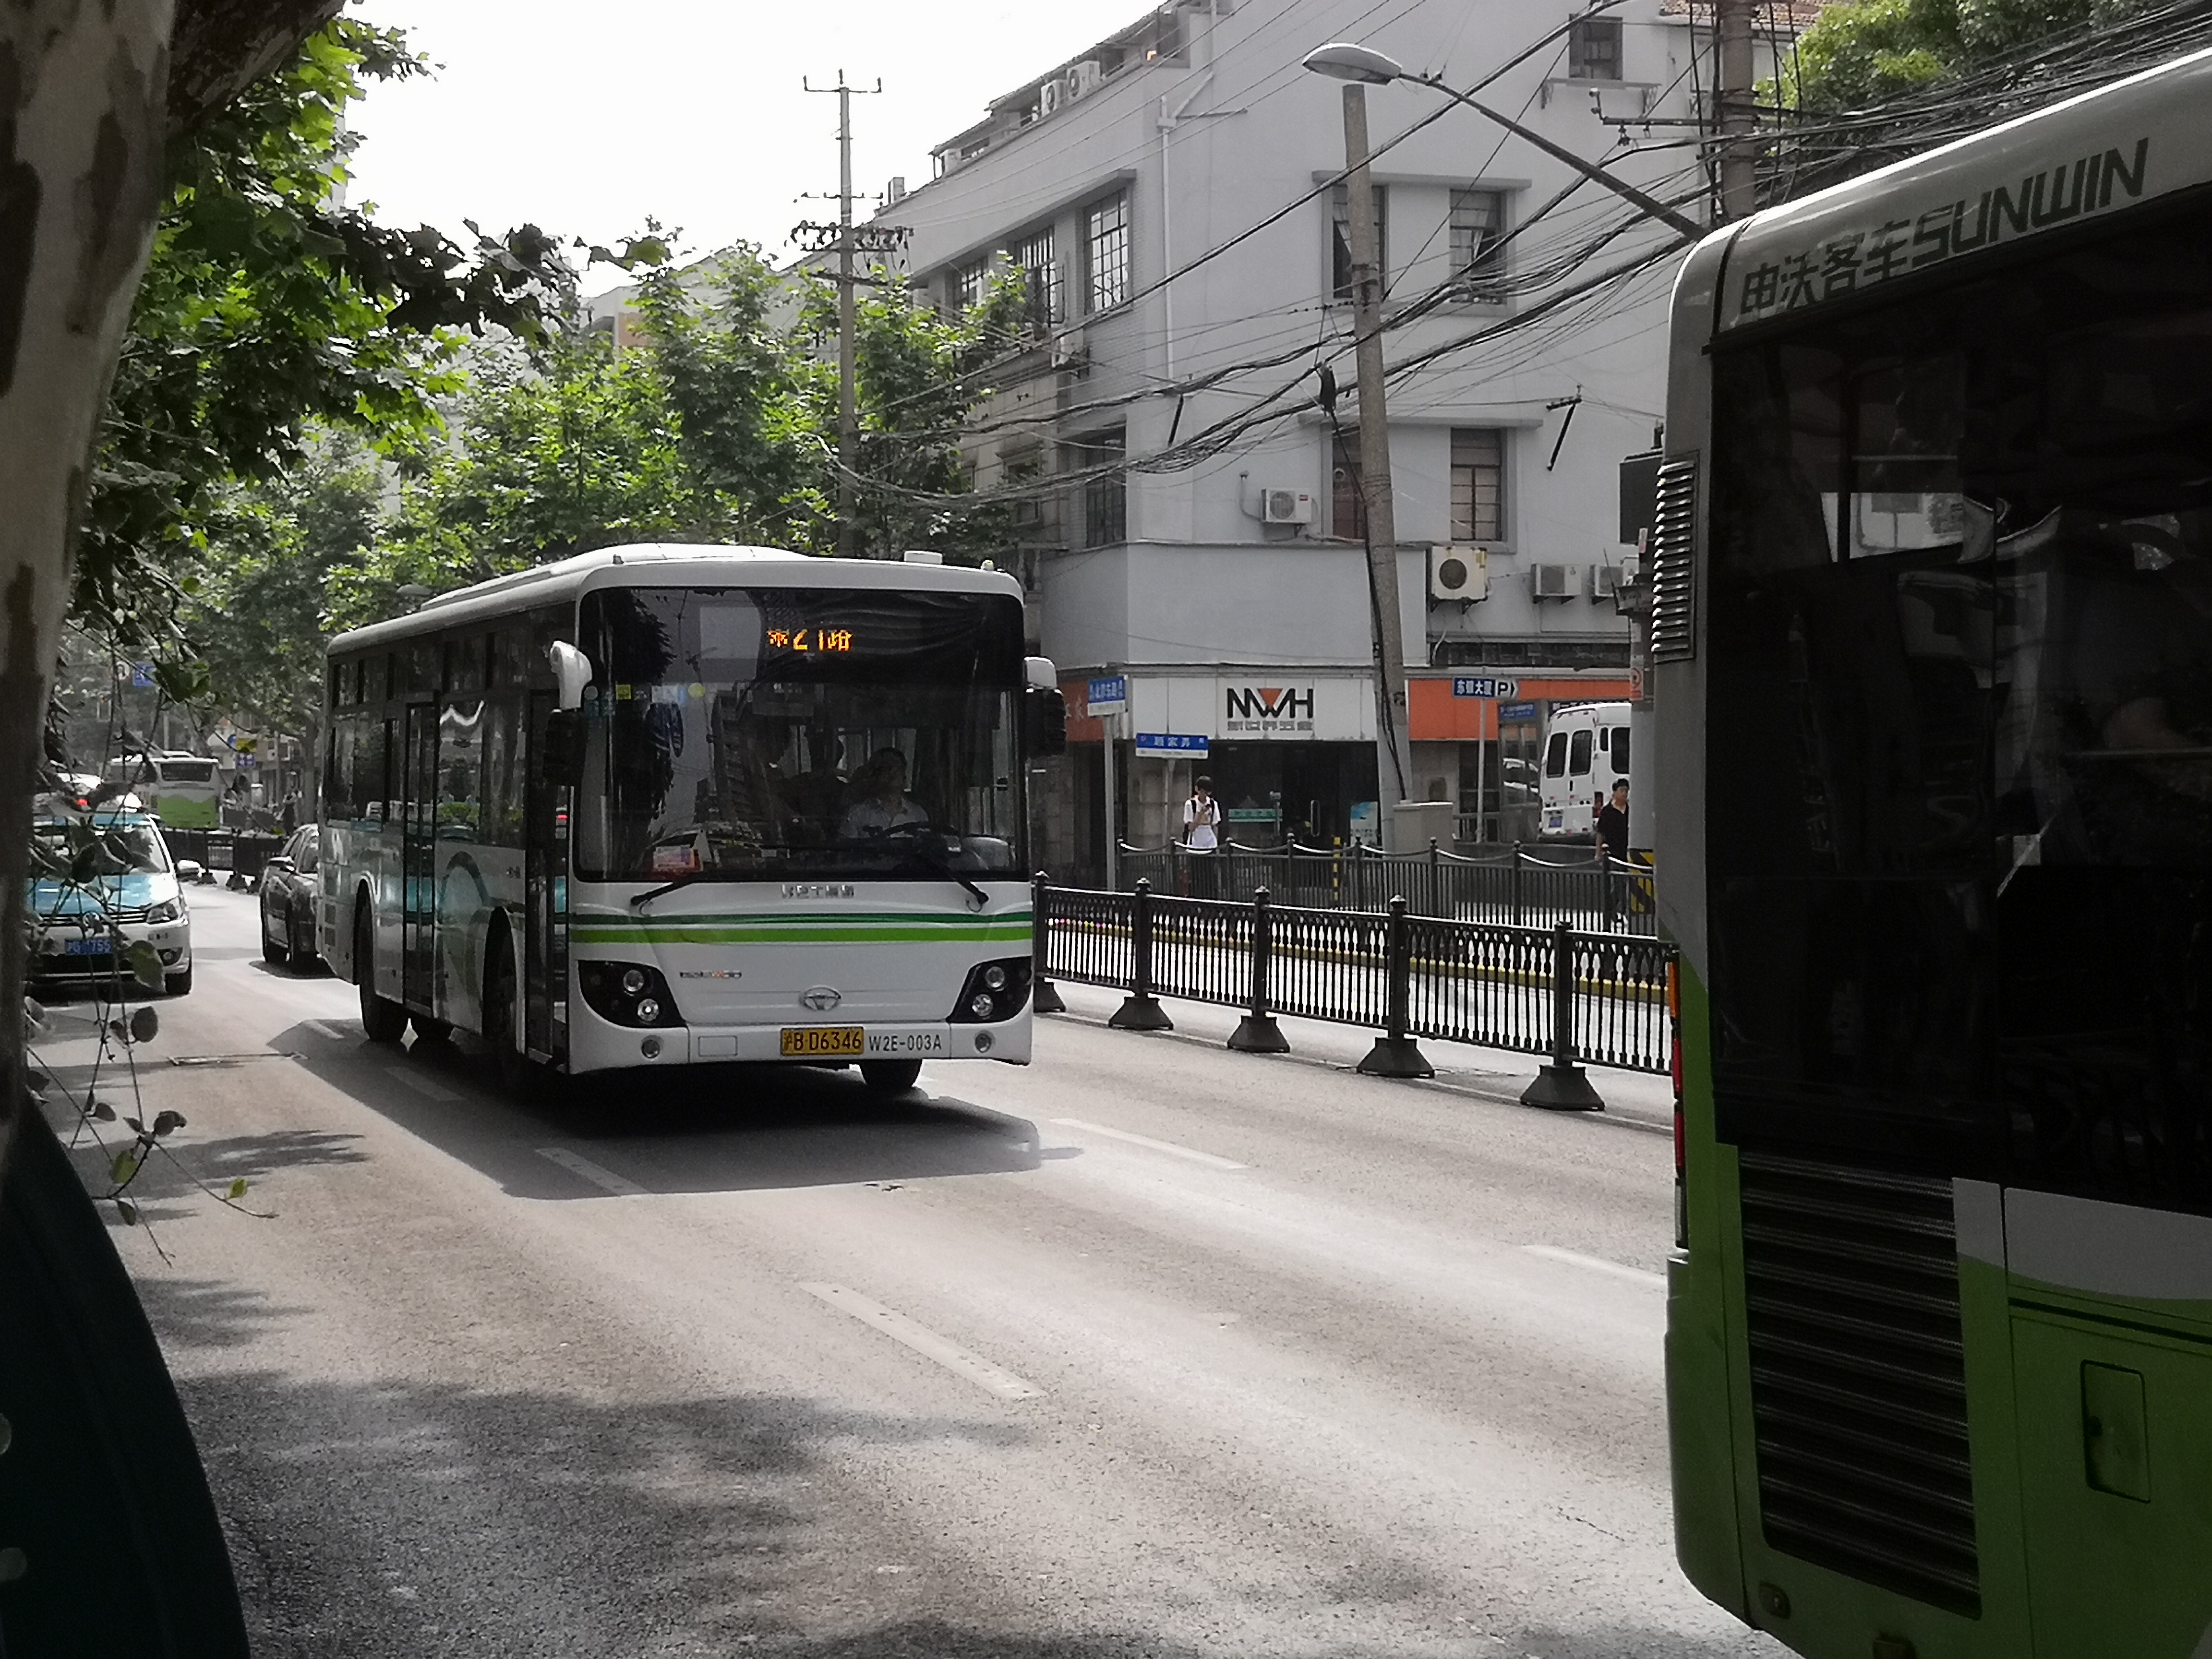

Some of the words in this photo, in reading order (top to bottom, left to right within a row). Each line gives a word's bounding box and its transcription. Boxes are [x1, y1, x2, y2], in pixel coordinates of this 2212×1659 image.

[1912, 137, 2149, 269] SUNWIN
[1227, 688, 1314, 719] NWH
[868, 1034, 942, 1052] W2E-003A
